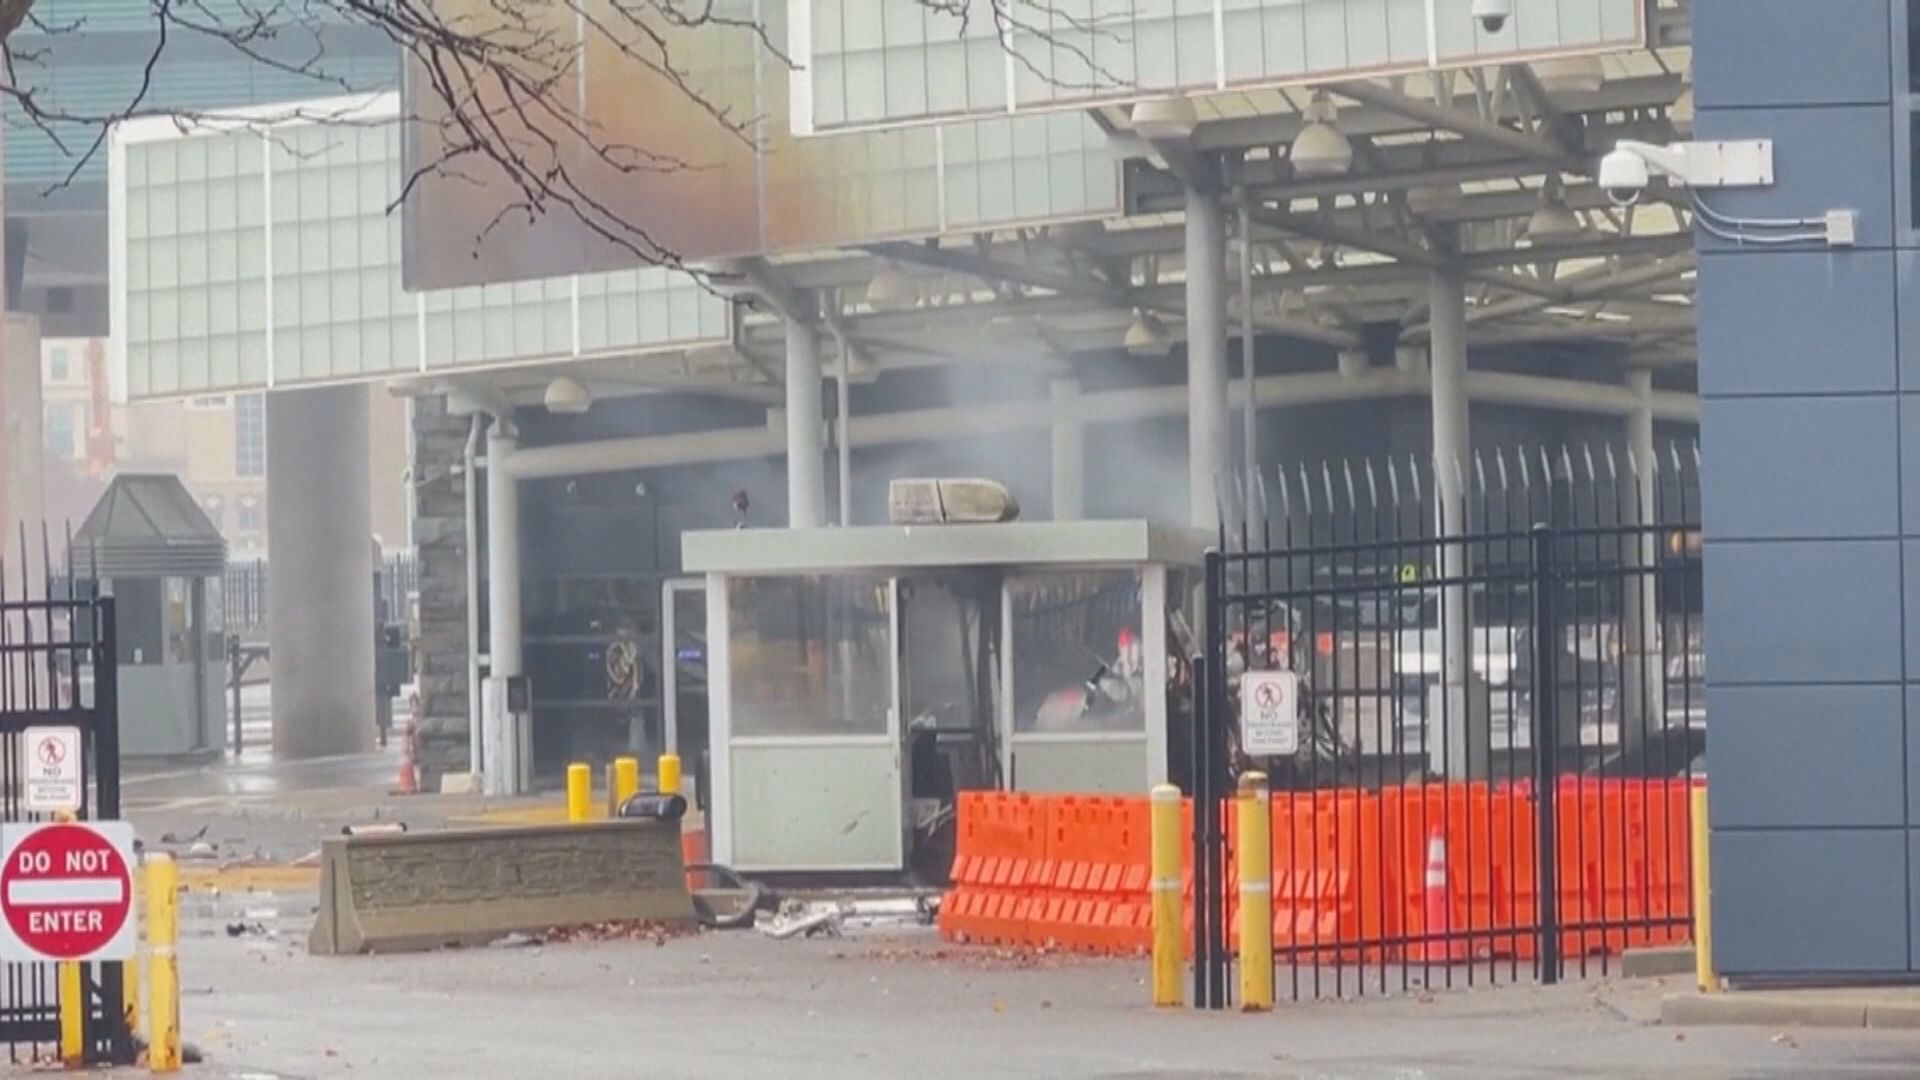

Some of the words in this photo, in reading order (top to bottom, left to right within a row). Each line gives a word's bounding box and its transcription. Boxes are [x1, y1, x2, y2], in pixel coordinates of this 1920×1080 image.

[43, 768, 62, 776] NO
[19, 851, 51, 873] DO
[65, 849, 111, 872] NOT
[29, 910, 103, 933] ENTER
